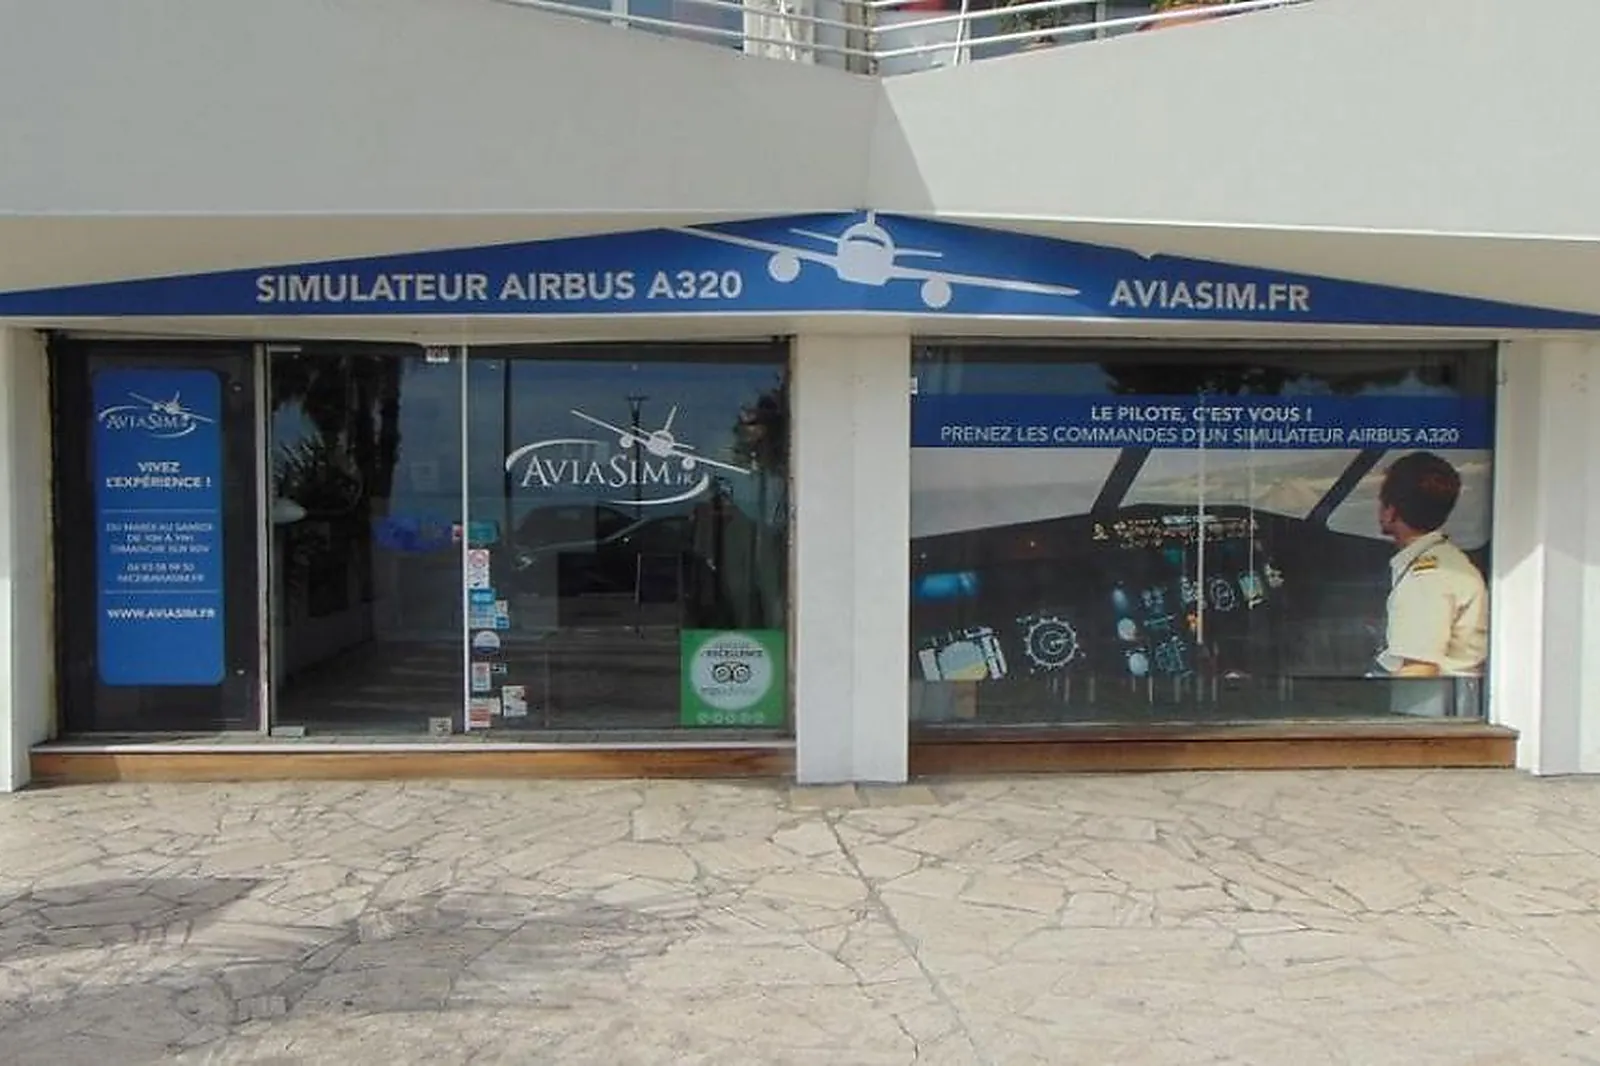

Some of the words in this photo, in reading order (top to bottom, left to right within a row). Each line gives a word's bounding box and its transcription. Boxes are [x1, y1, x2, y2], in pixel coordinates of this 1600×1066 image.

[255, 273, 488, 302] SIMULATEUR
[500, 271, 635, 300] AIRBUS
[647, 271, 743, 299] A320
[1108, 280, 1311, 312] AVIASIM.FR
[1091, 406, 1112, 421] LE
[1117, 406, 1187, 424] PILOTE,
[1193, 407, 1243, 422] C'EST
[1248, 407, 1300, 422] VOUS
[941, 426, 1012, 442] PRENEZ
[1017, 426, 1049, 442] LES
[1053, 426, 1178, 443] COMMANDES
[1182, 428, 1228, 443] D'UN
[1233, 428, 1345, 443] SIMULATEUR
[1348, 428, 1411, 443] AIRBUS
[1415, 428, 1460, 443] A320
[137, 461, 181, 473] VIVEZ
